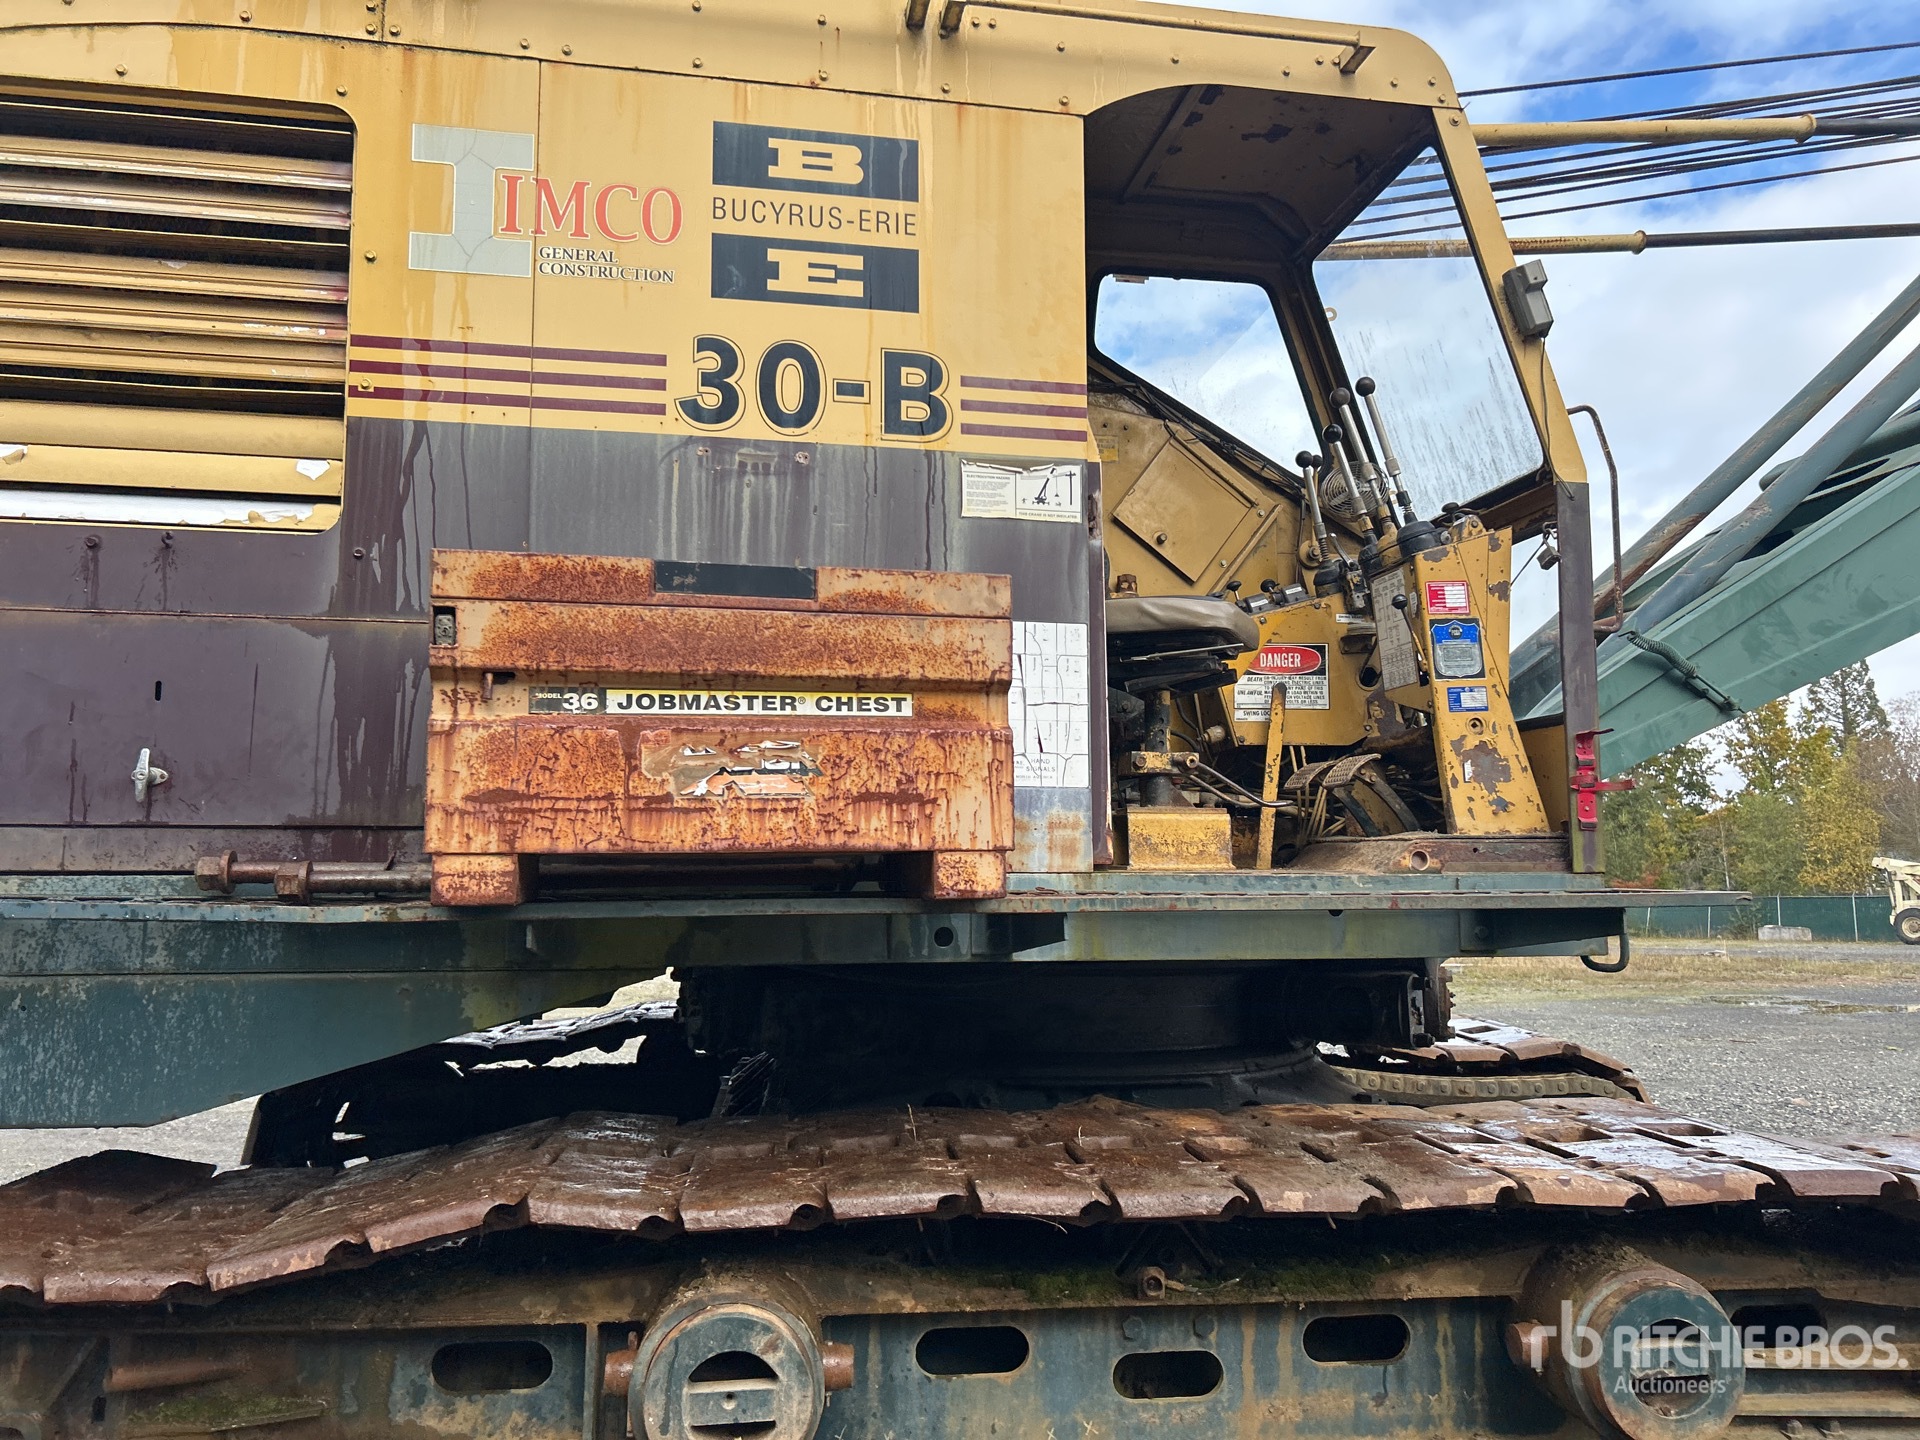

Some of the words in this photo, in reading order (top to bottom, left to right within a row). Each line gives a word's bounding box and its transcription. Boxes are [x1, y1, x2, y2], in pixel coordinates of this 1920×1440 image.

[768, 137, 865, 185] B
[499, 172, 684, 246] IMCO
[711, 196, 919, 238] BUCYRUS-ERIE
[537, 261, 675, 284] CONSTRUCTION
[538, 245, 619, 264] GENERAL
[767, 248, 865, 298] E
[674, 333, 954, 443] 30-B
[1260, 653, 1301, 667] DANGER
[562, 692, 599, 710] 36
[815, 695, 908, 714] CHEST
